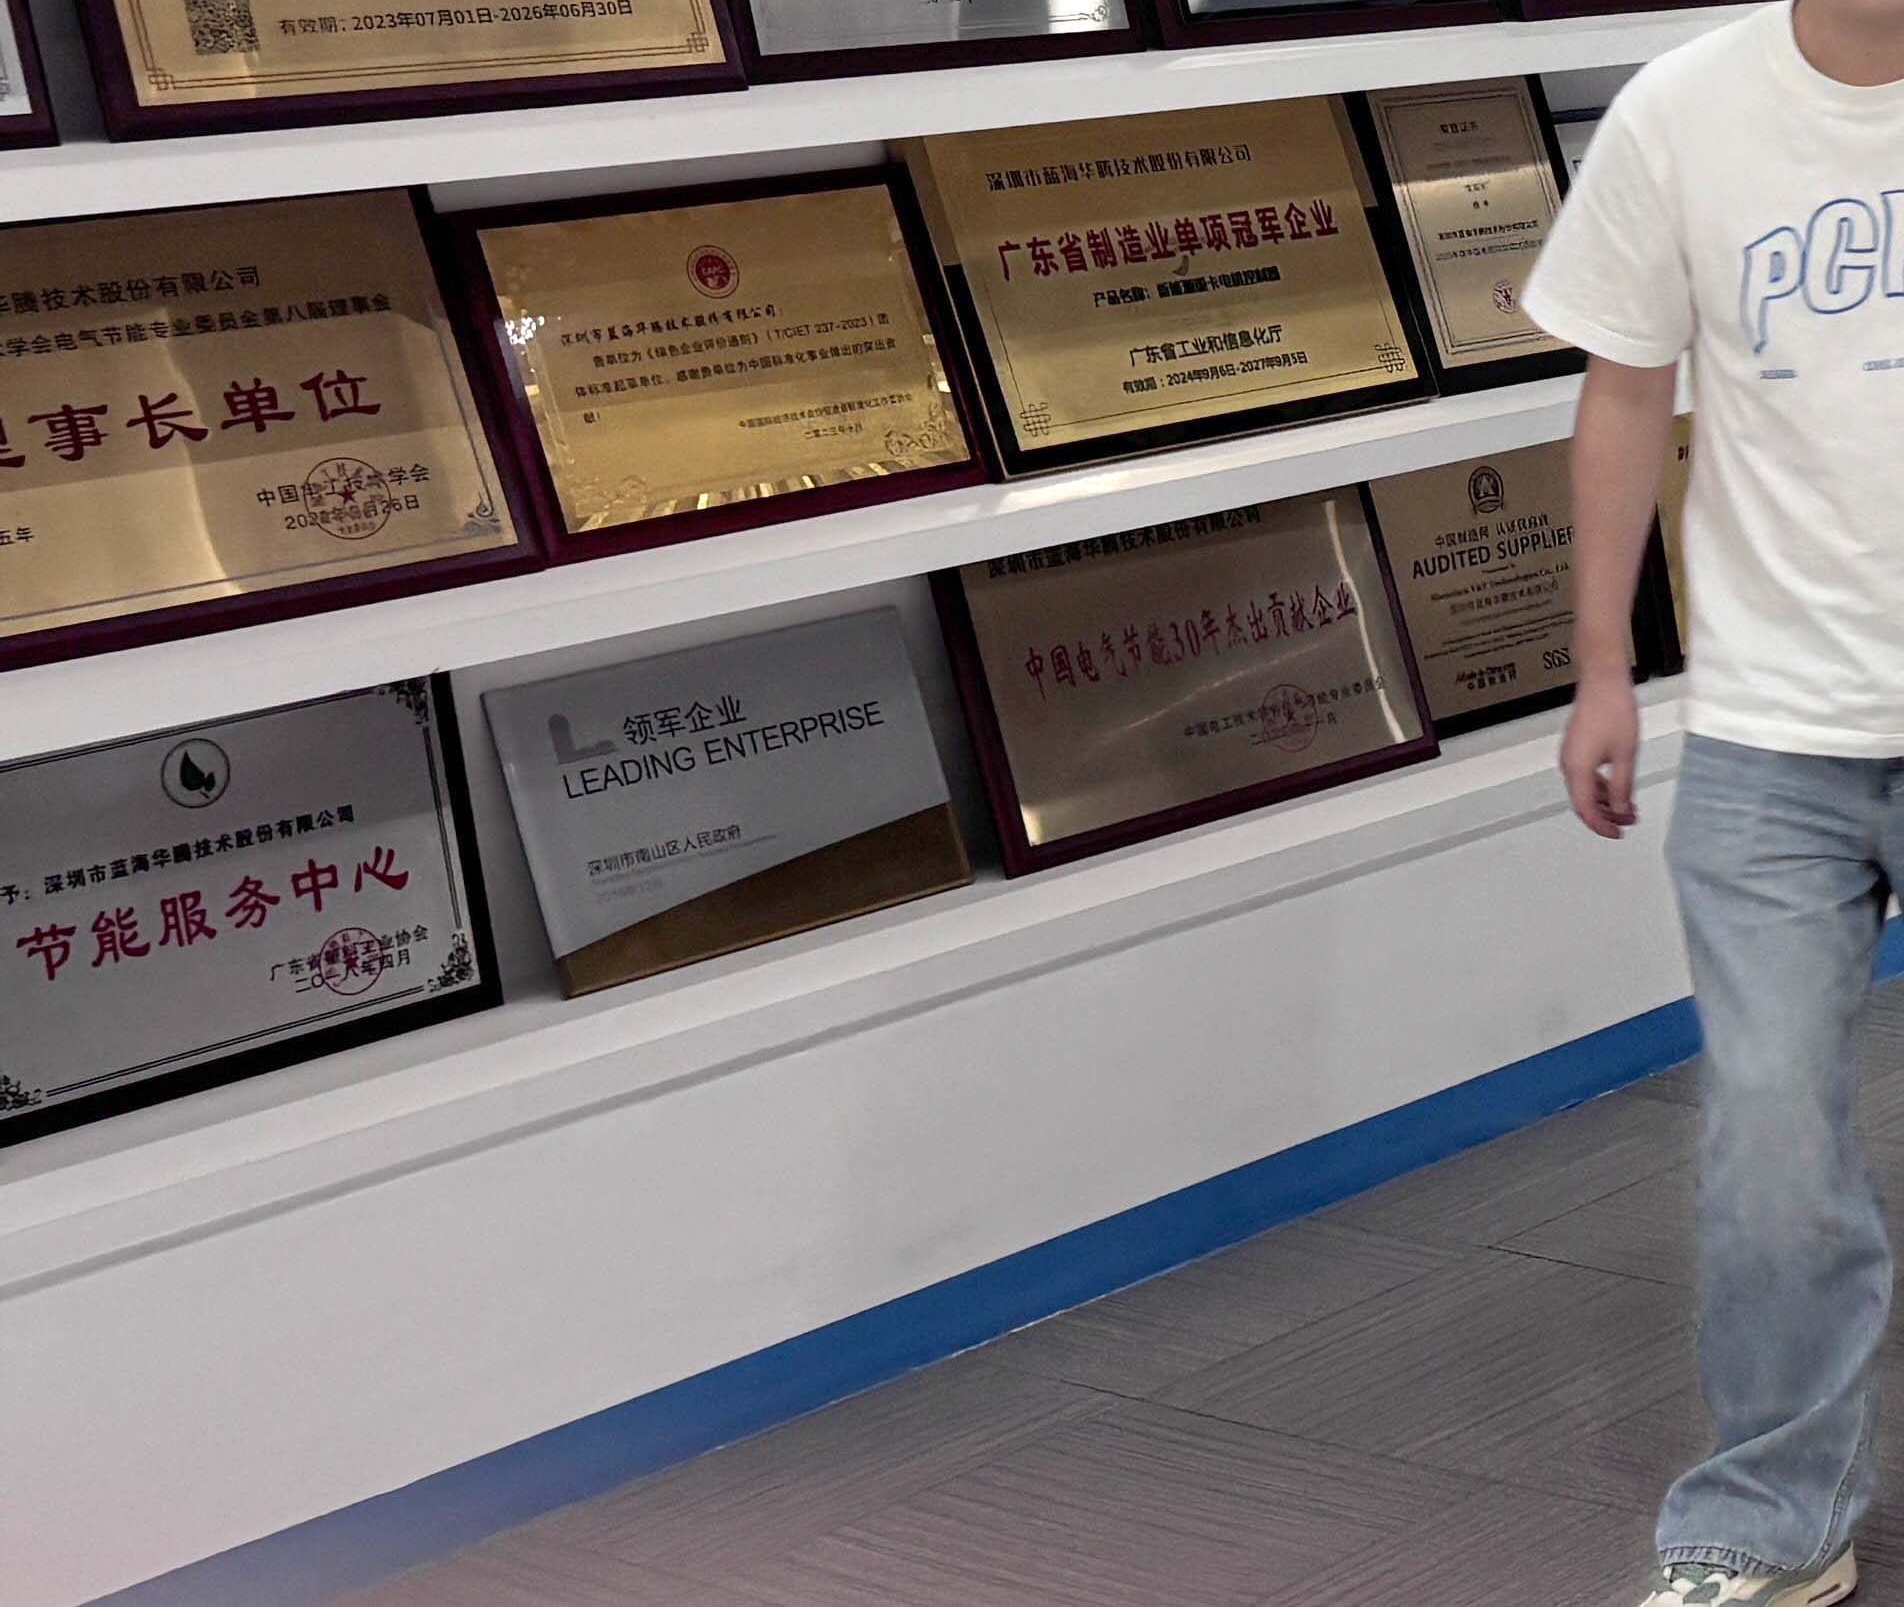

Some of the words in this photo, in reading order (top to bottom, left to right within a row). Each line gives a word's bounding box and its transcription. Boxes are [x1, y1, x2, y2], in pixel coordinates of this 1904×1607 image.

[985, 143, 1252, 193] 深圳市蓝海华腾技术股份有限公司
[998, 198, 1340, 281] 广东省制造业单项冠军企业
[1129, 324, 1282, 367] 广东省工业和信息化厅
[1412, 546, 1491, 580] AUDITED
[1543, 648, 1571, 670] SGS
[623, 694, 747, 747] 领军企业
[562, 745, 697, 800] LEADING
[705, 700, 885, 766] ENTERPRISE
[587, 823, 742, 878] 深圳市南山区人民政府
[15, 846, 410, 982] 节能服务中心
